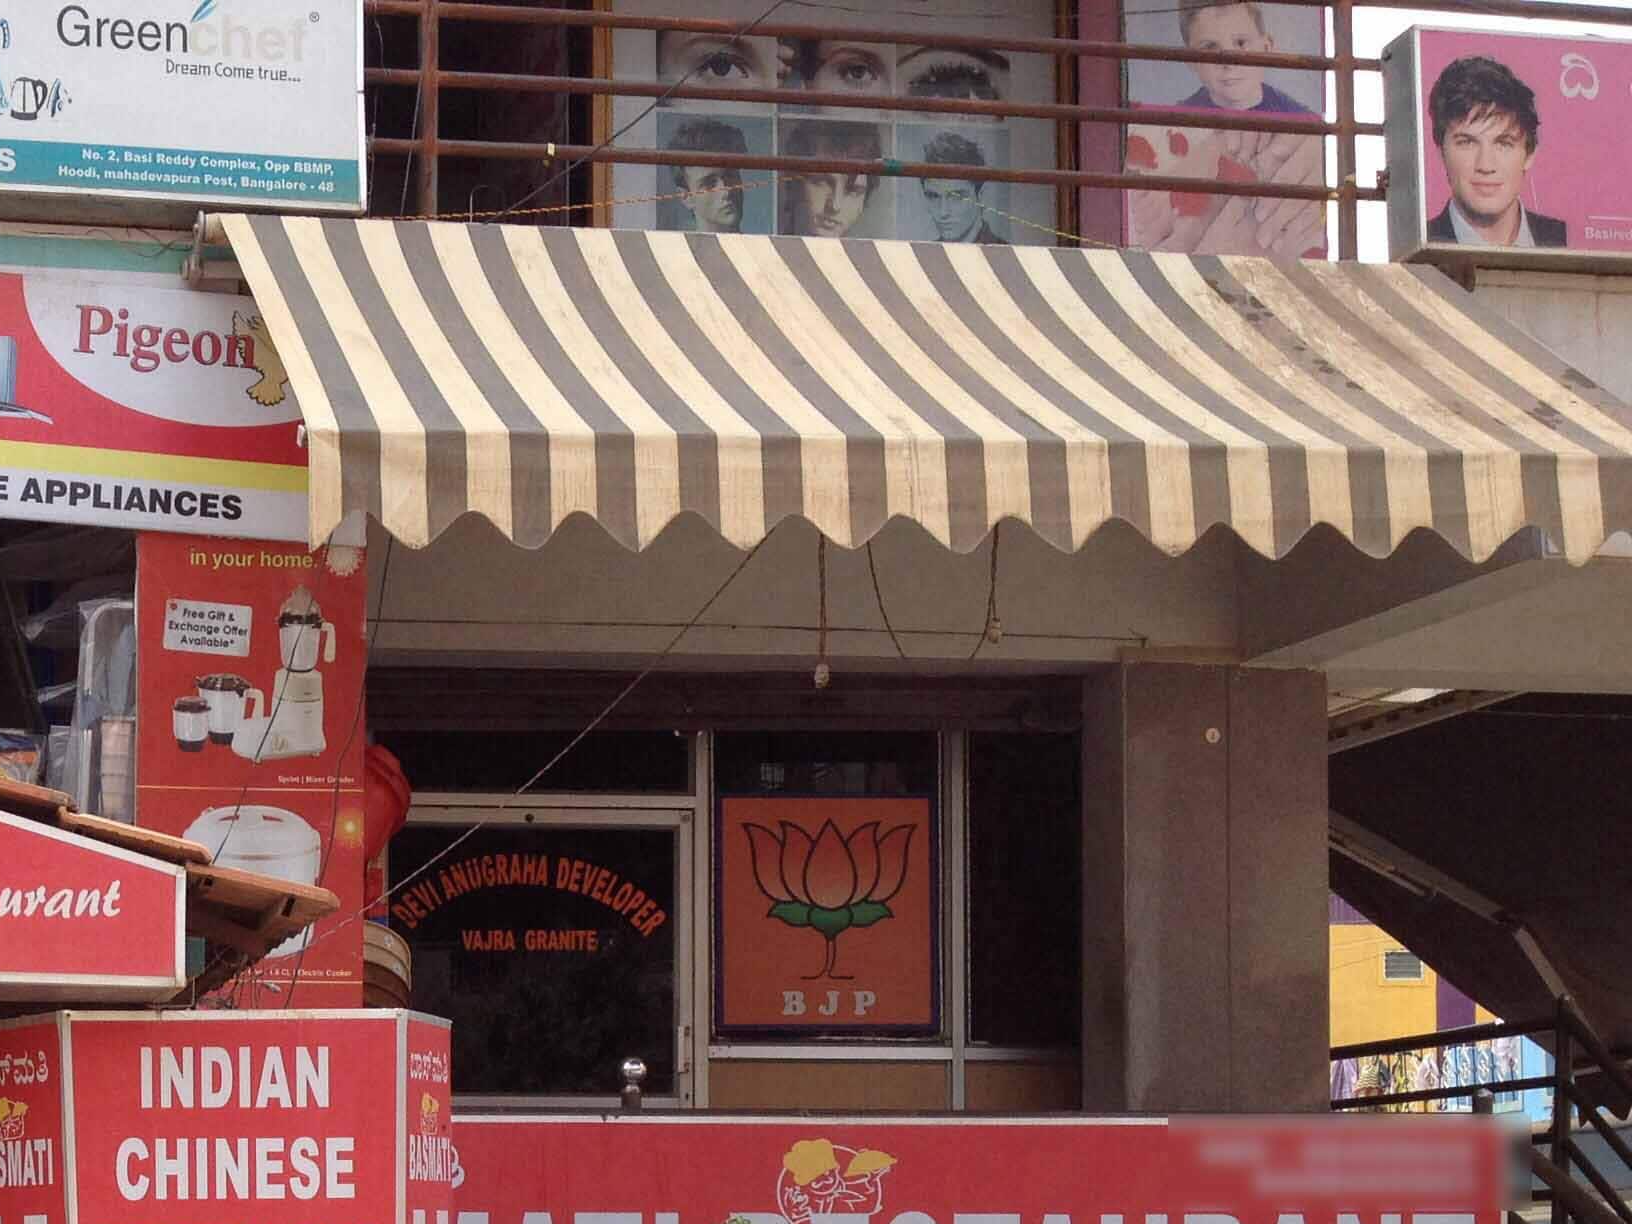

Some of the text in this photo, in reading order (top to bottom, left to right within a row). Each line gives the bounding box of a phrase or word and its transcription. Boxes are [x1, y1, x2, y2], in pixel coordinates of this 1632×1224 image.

[166, 59, 211, 77] Dream
[215, 63, 254, 79] Come
[200, 156, 261, 173] Complex,
[241, 177, 305, 193] Bangalore
[76, 304, 257, 378] Pigeon
[20, 478, 242, 522] APPLIANCES
[190, 548, 319, 570] in your home.
[182, 608, 205, 620] Free
[168, 620, 248, 637] Exchange Offer
[391, 854, 666, 938] DEVI ANUGRAHA DEVELOPER
[462, 929, 598, 954] VAJRA GRANITE
[139, 1045, 330, 1110] INDIAN
[116, 1136, 356, 1201] CHINESE
[409, 1134, 451, 1182] BASMATI
